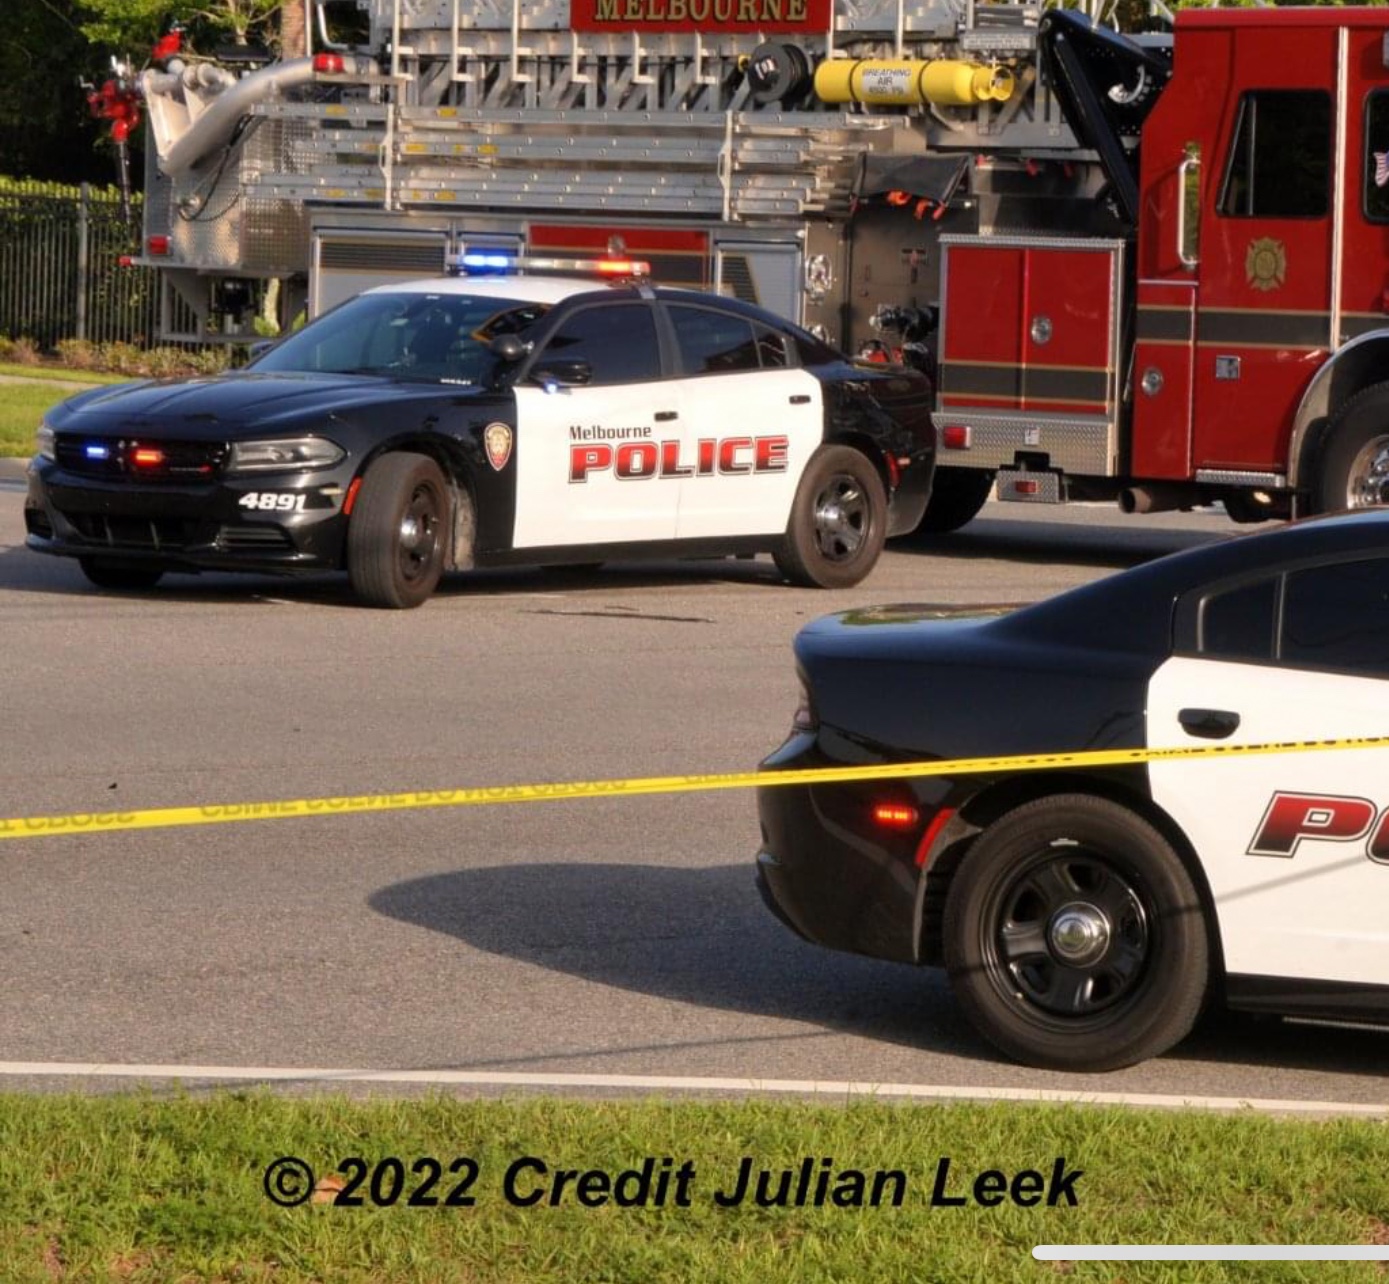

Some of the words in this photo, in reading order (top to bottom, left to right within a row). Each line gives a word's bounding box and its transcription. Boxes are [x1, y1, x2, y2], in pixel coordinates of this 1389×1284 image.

[594, 0, 808, 21] MELBOURNE
[877, 76, 893, 86] AIR
[569, 425, 652, 440] Melbourne
[568, 434, 789, 484] POLICE
[238, 492, 307, 513] 4891
